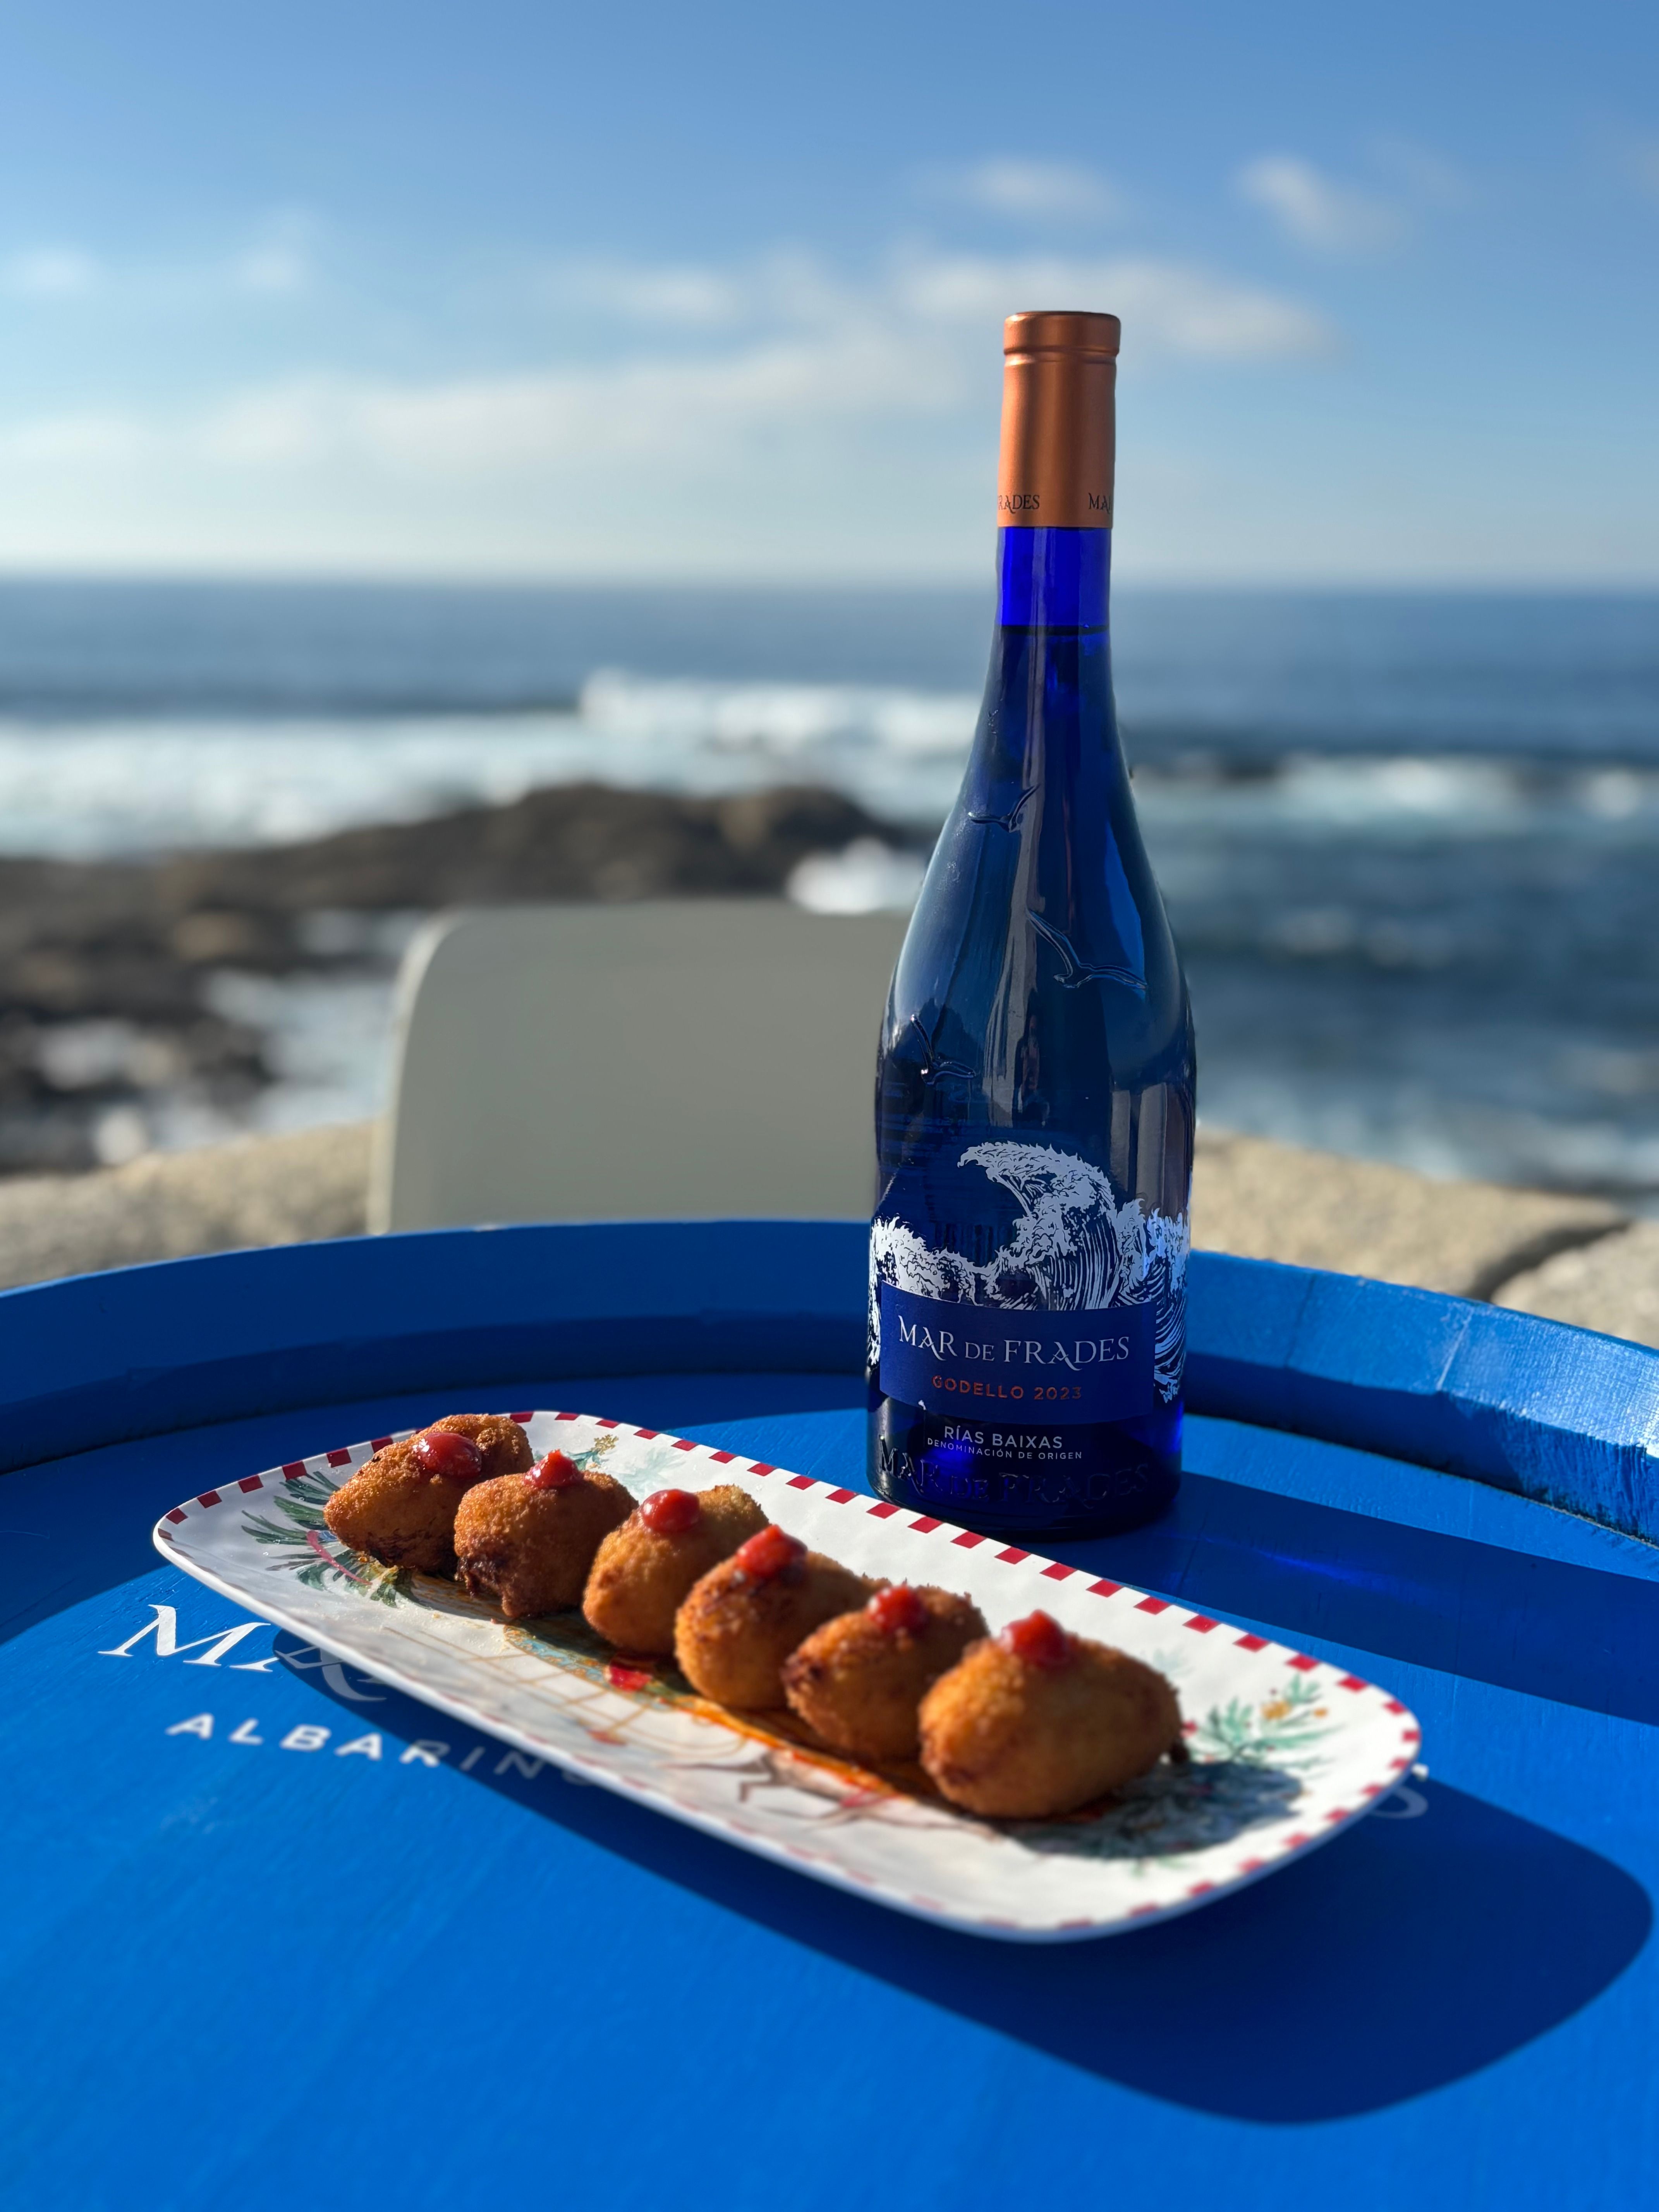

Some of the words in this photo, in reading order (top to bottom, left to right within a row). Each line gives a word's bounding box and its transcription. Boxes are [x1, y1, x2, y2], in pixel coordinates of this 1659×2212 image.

[998, 495, 1040, 514] RADES
[899, 1315, 957, 1361] MAR
[965, 1342, 994, 1362] DE
[1004, 1336, 1130, 1371] FRADES
[931, 1375, 1024, 1400] GODELLO
[1034, 1387, 1082, 1400] 2023
[927, 1437, 1012, 1458] DENOMINACIÓN
[1038, 1451, 1082, 1460] ORIGEN
[944, 1425, 984, 1444] RÍAS
[992, 1434, 1063, 1449] BAIXAS
[878, 1434, 943, 1497] MAR
[98, 1604, 388, 1702] MA
